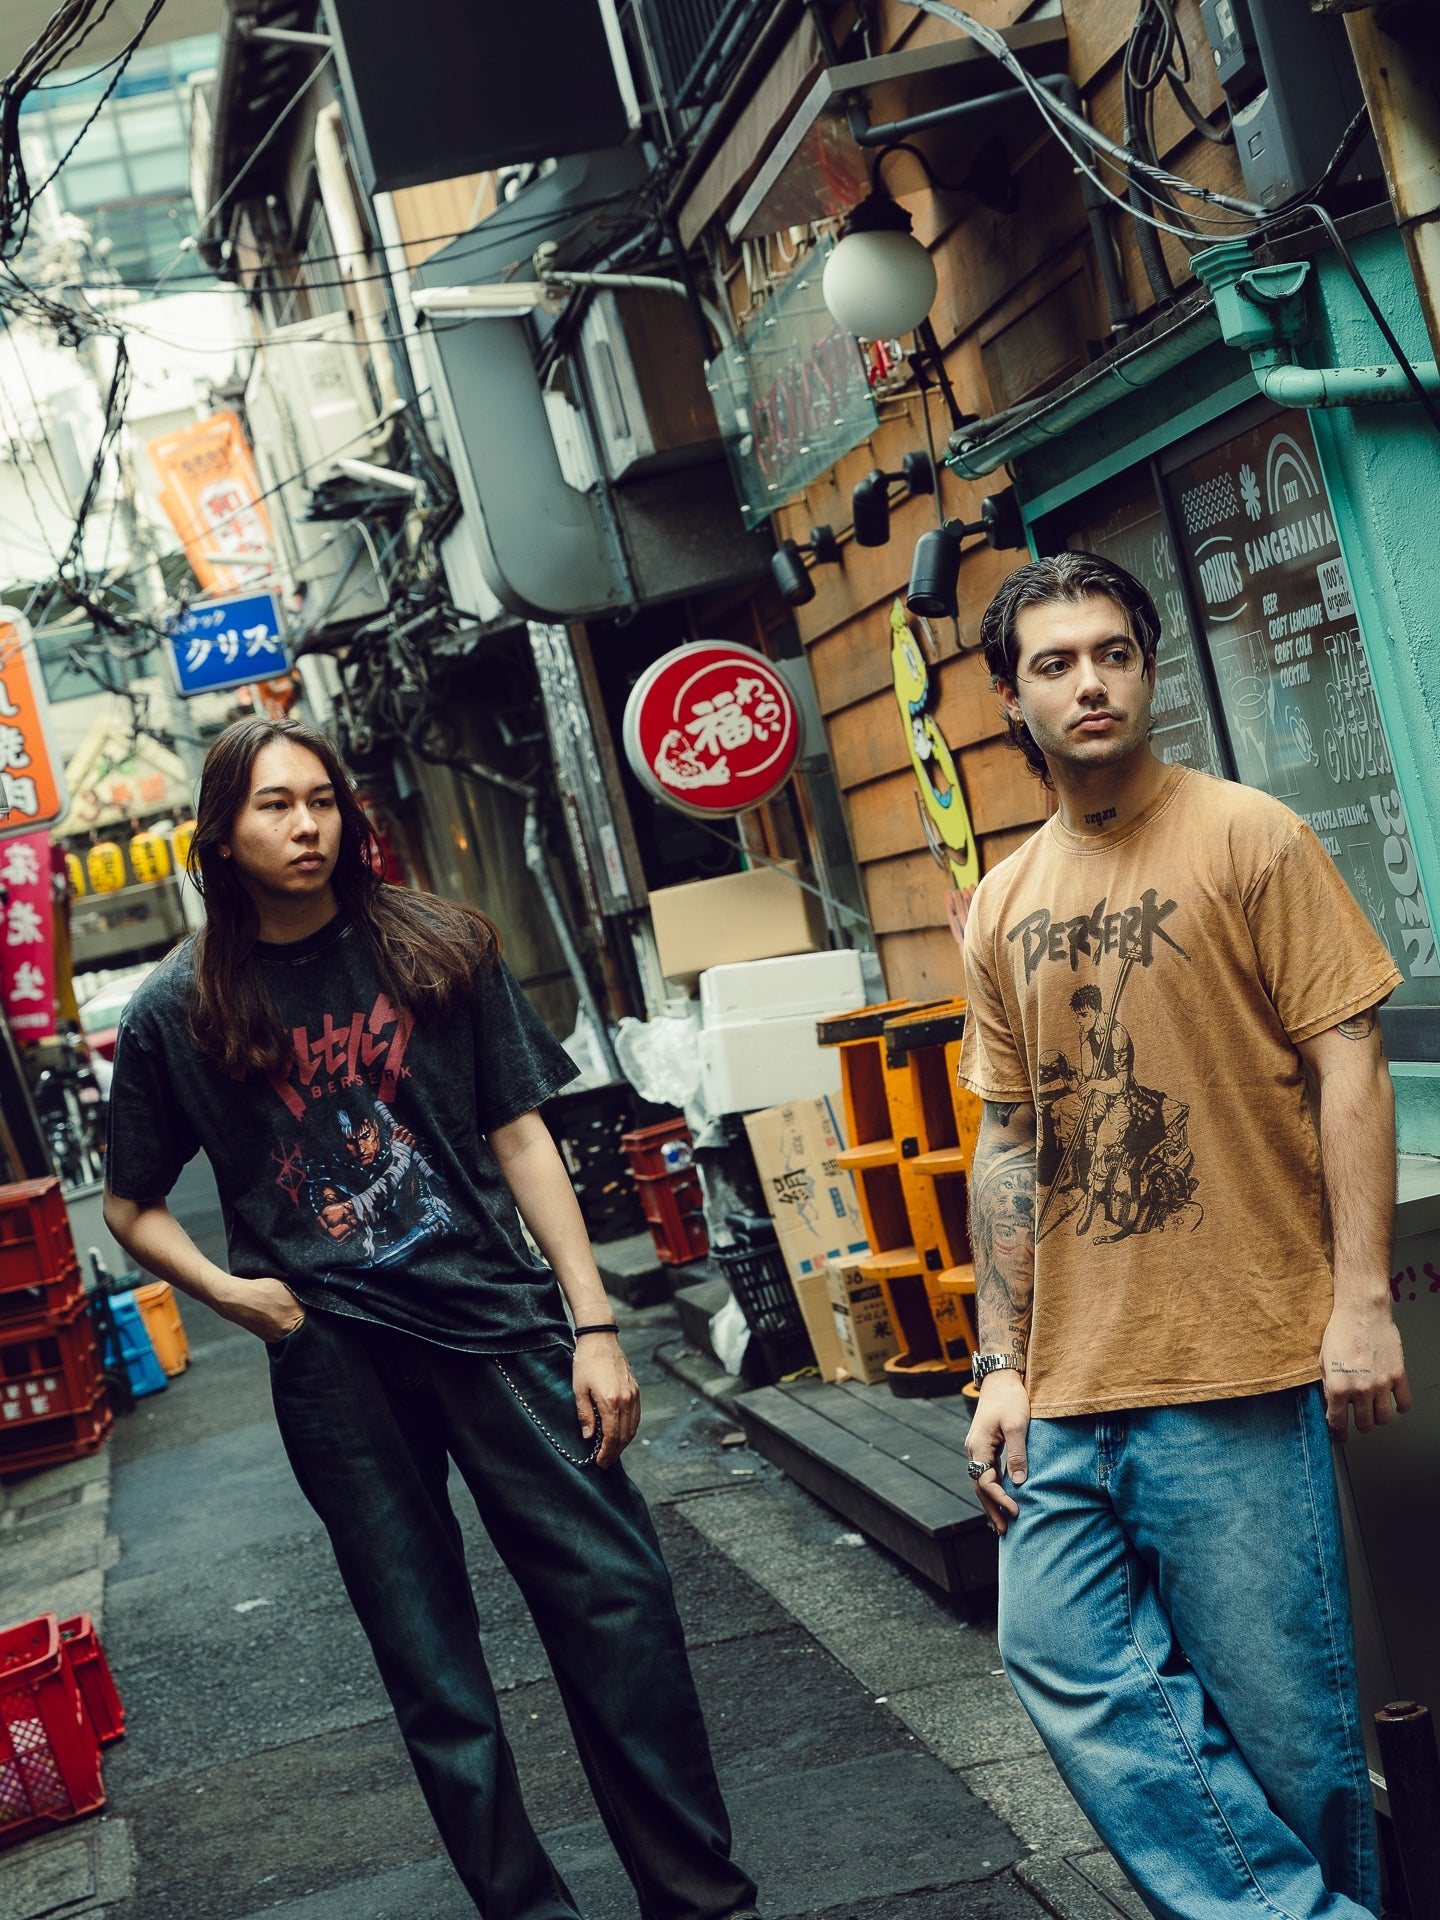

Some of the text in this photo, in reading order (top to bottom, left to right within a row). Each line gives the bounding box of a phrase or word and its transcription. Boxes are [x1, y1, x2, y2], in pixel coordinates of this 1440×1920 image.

[1244, 510, 1337, 574] SANGENJAYA
[1198, 551, 1244, 604] DRINKS
[1322, 564, 1345, 590] 100%
[1262, 592, 1279, 616] BEER
[1268, 602, 1324, 640] CRAFT LEMONADE
[1274, 633, 1313, 665] CRAFT COLA
[1280, 660, 1311, 689] COCKTAIL
[1084, 806, 1118, 826] vegan
[1312, 808, 1340, 831] GYOZA
[1338, 803, 1370, 828] FILLING
[1006, 888, 1192, 986] BERSERK
[310, 1066, 412, 1098] BERSERK
